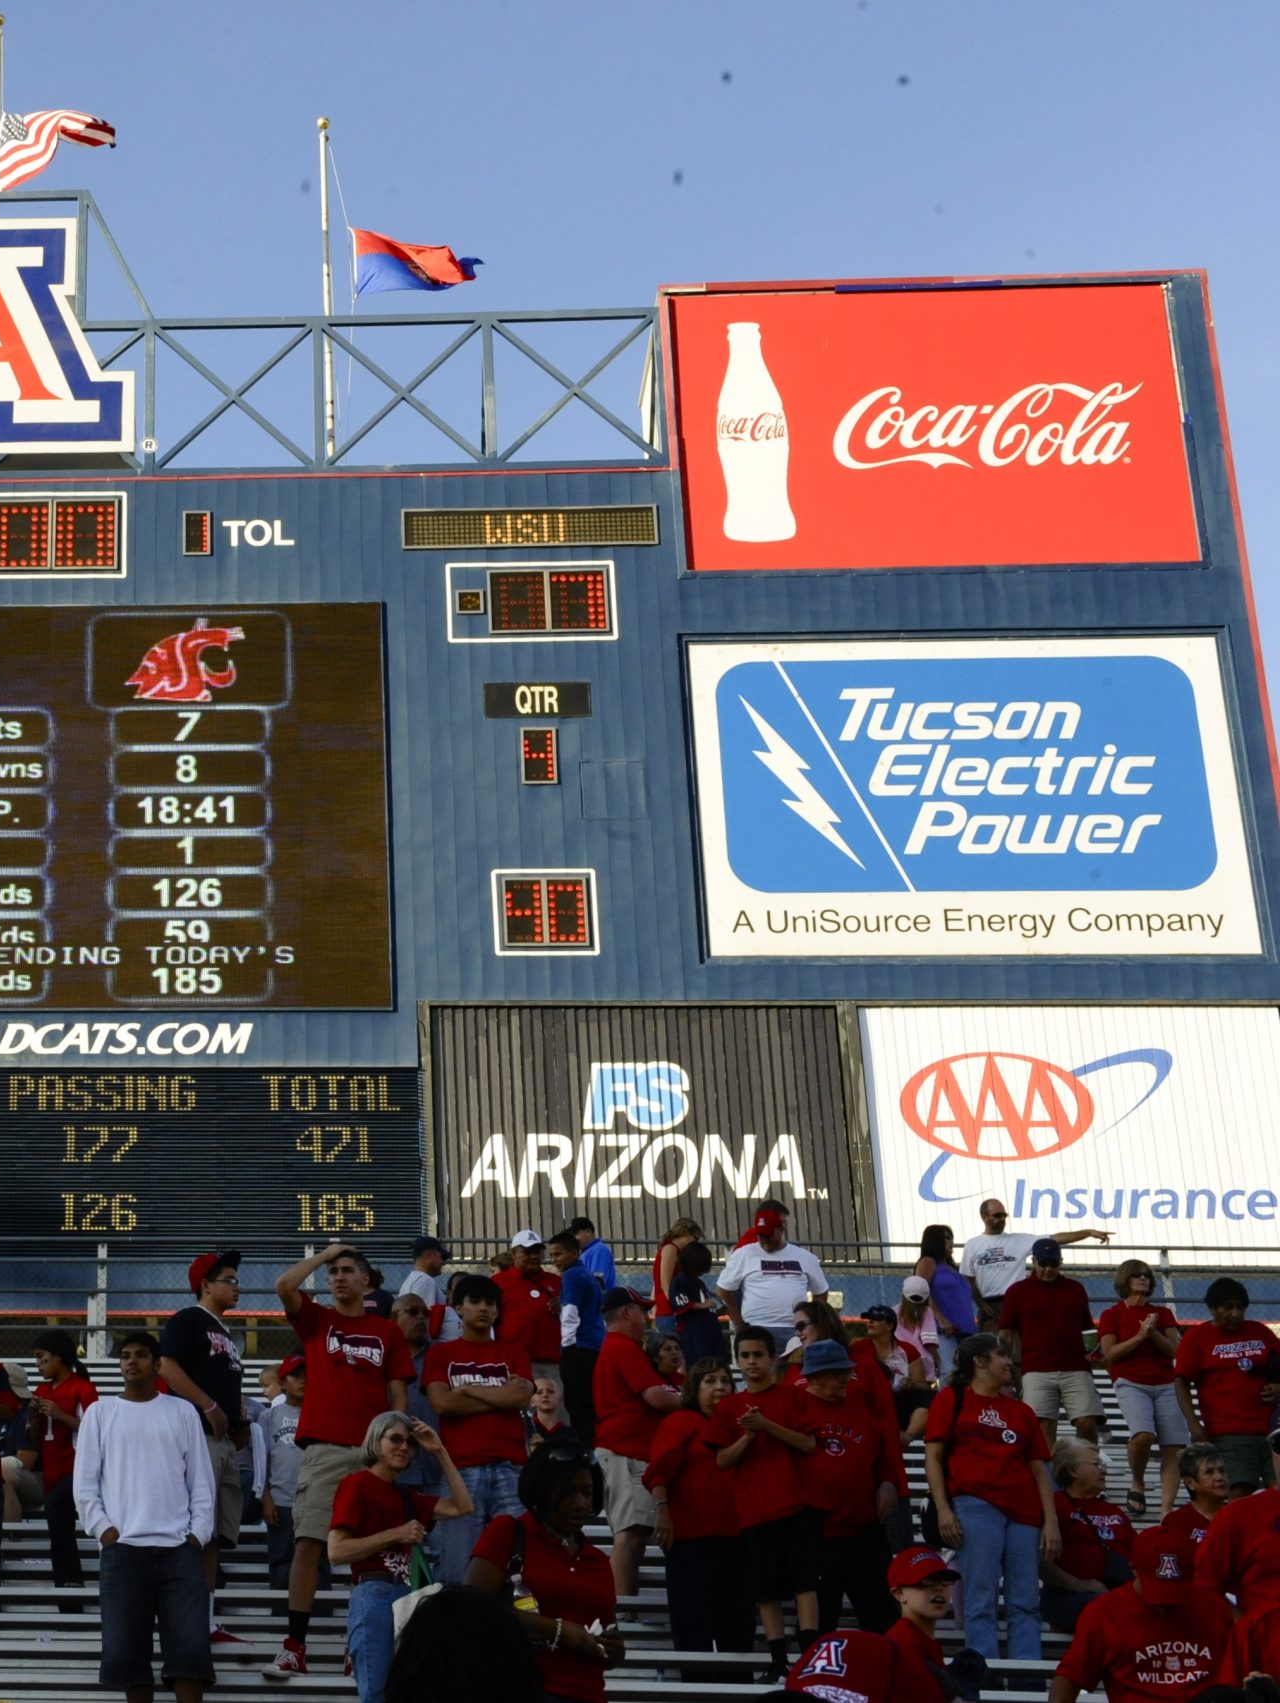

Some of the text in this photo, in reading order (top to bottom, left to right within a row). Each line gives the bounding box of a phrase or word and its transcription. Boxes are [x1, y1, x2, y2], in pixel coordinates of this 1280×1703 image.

[833, 382, 1144, 469] Coca-Cola
[222, 520, 295, 547] TOL
[484, 513, 566, 544] WSU
[550, 573, 606, 629] 7
[515, 685, 559, 714] QTR
[839, 688, 1083, 741] Tucson
[174, 711, 202, 741] 7
[176, 755, 198, 783] 8
[523, 731, 555, 780] 4
[868, 743, 1156, 796] Electric
[137, 796, 236, 824] 18:41
[904, 802, 1162, 854] Power
[177, 836, 194, 864] 1
[152, 878, 222, 908] 126
[504, 882, 587, 943] 40
[732, 907, 1224, 938] A UniSource Energy Company
[164, 920, 211, 943] 59
[146, 946, 295, 964] TODAY'S
[152, 967, 222, 994] 185
[8, 1074, 197, 1111] PASSING
[261, 1074, 400, 1111] TOTAL
[583, 1061, 689, 1131] FS
[916, 1054, 1084, 1160] AAA
[61, 1125, 138, 1162] 177
[295, 1125, 373, 1162] 471
[460, 1133, 808, 1199] ARIZONA
[60, 1193, 138, 1231] 126
[296, 1193, 375, 1232] 185
[1013, 1179, 1278, 1221] Insurance
[1135, 1641, 1213, 1664] ARIZONA
